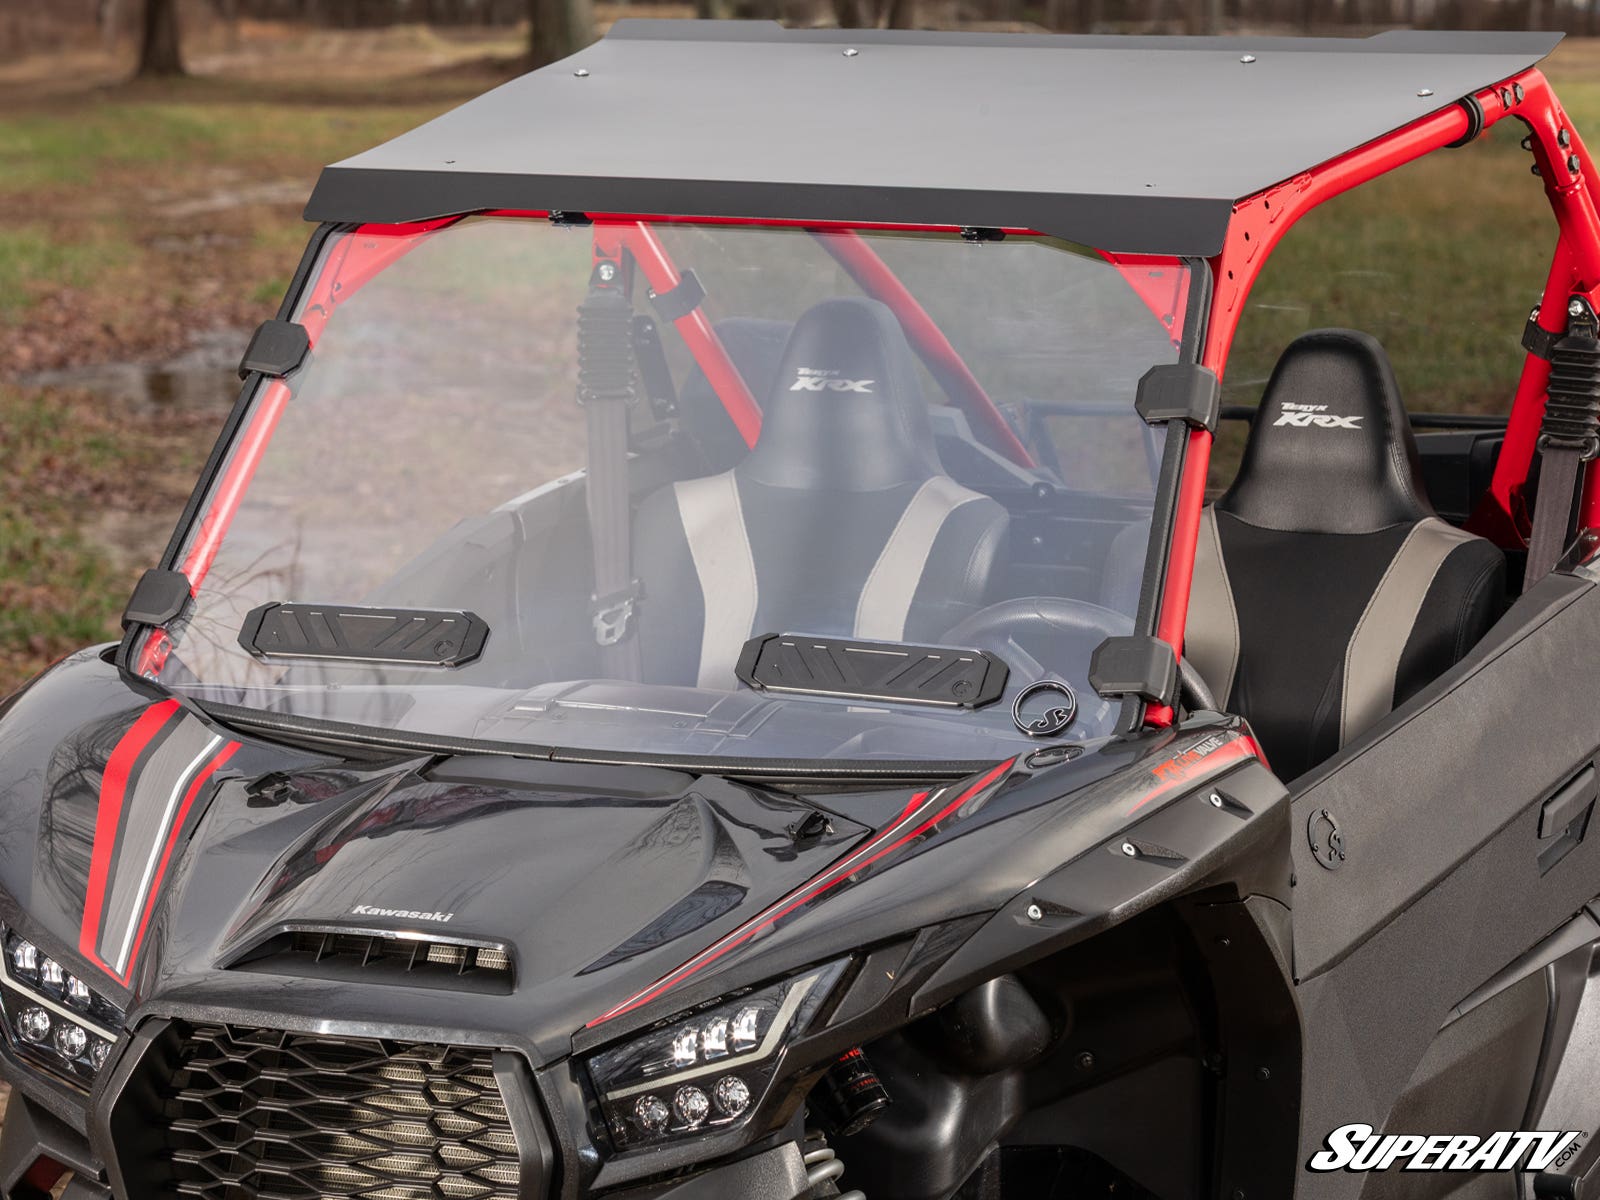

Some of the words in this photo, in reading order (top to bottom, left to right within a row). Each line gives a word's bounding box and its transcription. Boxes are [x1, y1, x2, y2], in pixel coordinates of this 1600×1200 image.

[789, 376, 875, 393] KRX
[1273, 411, 1364, 429] KRX
[352, 905, 454, 922] Kawasaki
